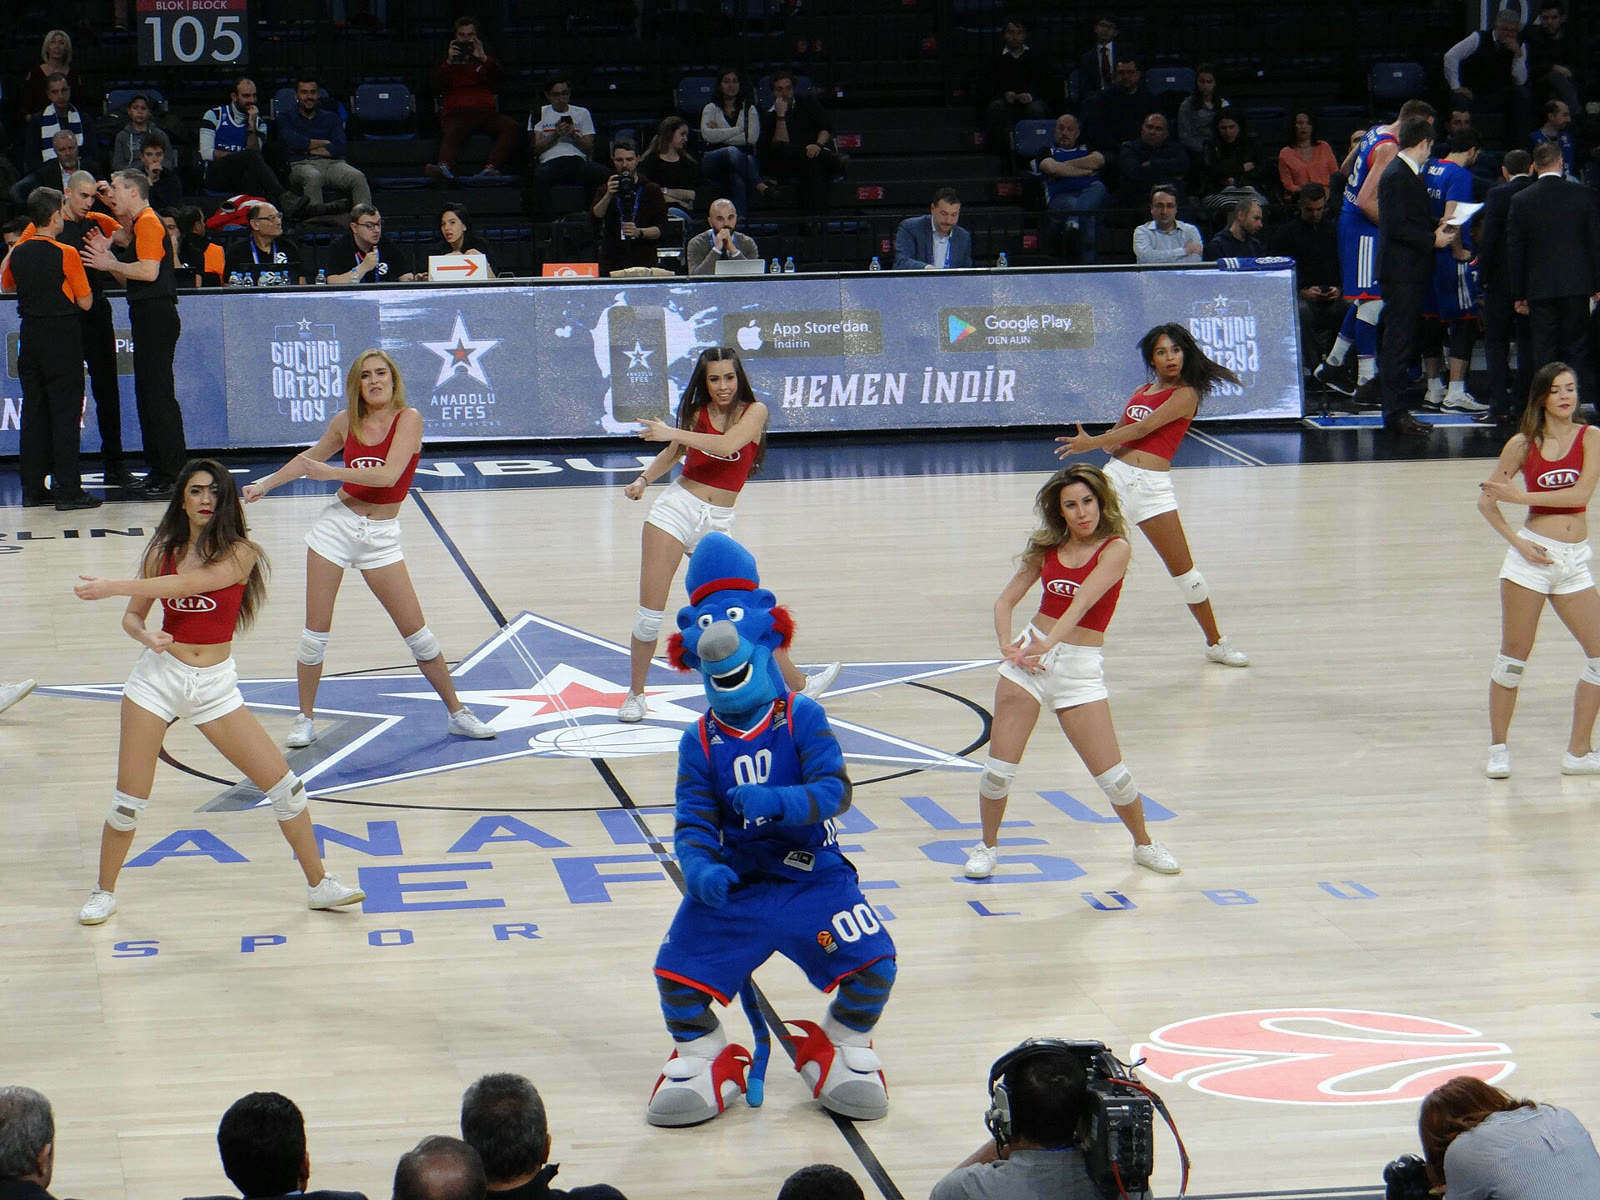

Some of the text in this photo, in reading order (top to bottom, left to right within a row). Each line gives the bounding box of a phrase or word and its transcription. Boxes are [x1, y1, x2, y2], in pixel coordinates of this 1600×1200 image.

[155, 0, 228, 11] BLOK BLOCK
[144, 15, 244, 63] 105
[772, 322, 801, 338] App
[984, 314, 1072, 333] Google Play
[114, 338, 135, 353] Pla
[780, 364, 1017, 409] HEMEN İNDİR
[430, 392, 497, 406] ANADOLU
[289, 399, 327, 423] KOY
[441, 405, 487, 420] EFES
[733, 748, 773, 786] 00
[831, 902, 881, 943] 00
[112, 922, 543, 958] SPOR
